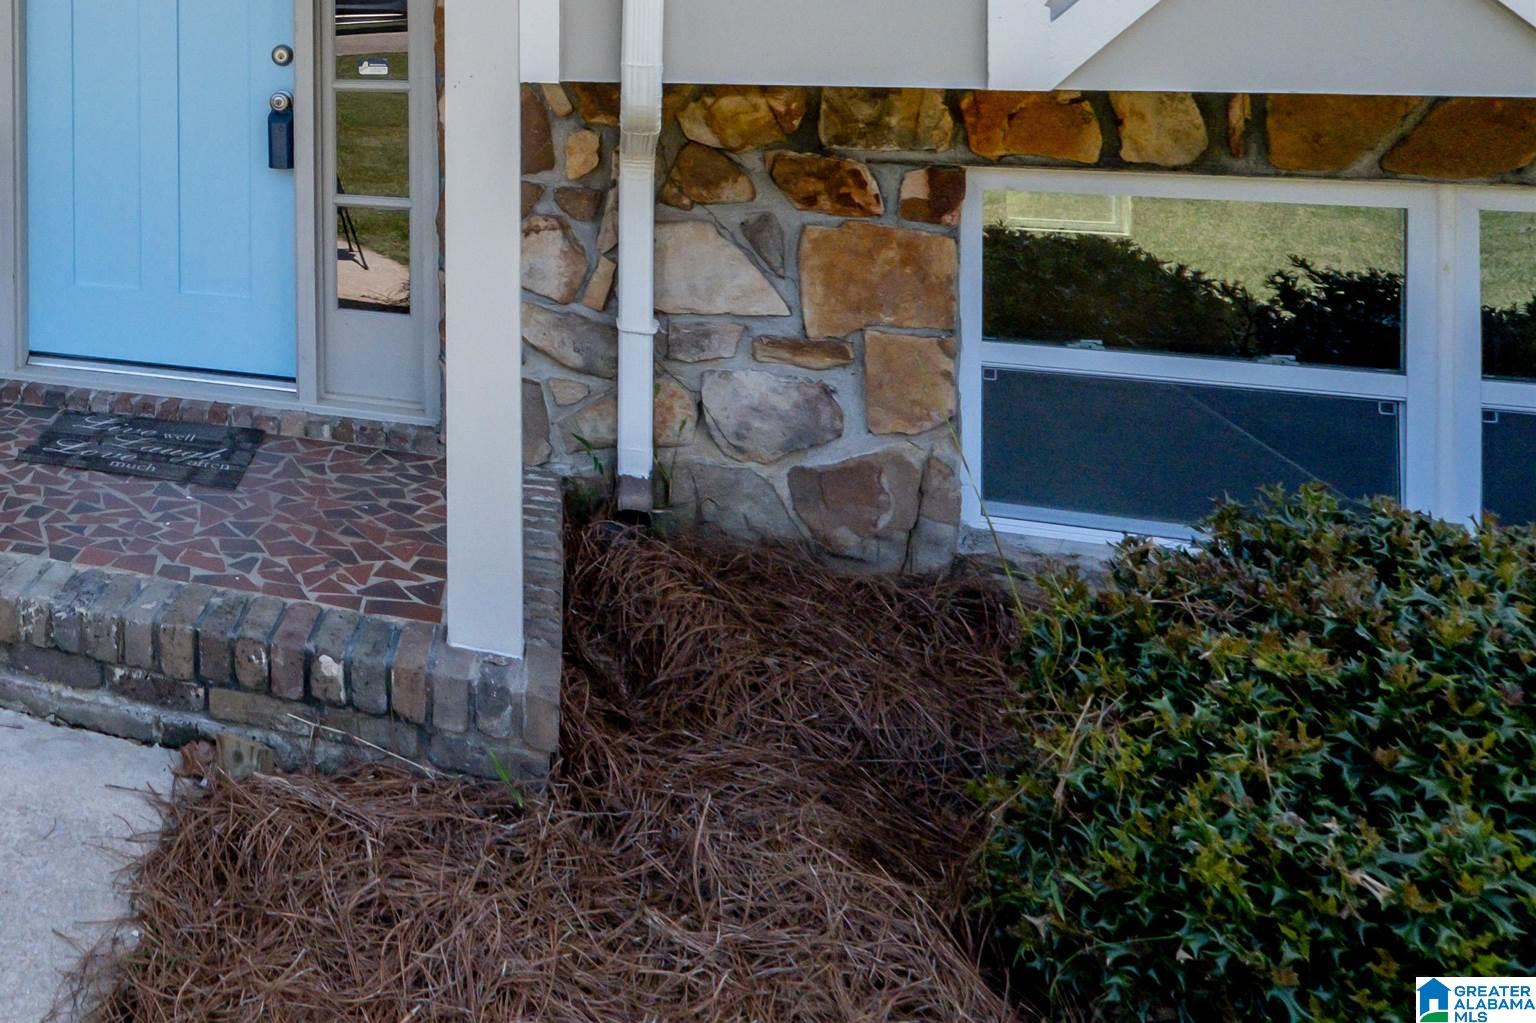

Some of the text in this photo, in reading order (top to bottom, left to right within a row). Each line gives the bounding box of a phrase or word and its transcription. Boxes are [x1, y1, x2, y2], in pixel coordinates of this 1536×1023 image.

[72, 416, 196, 442] Live well
[42, 438, 157, 473] Love much
[112, 435, 231, 471] Laugh often
